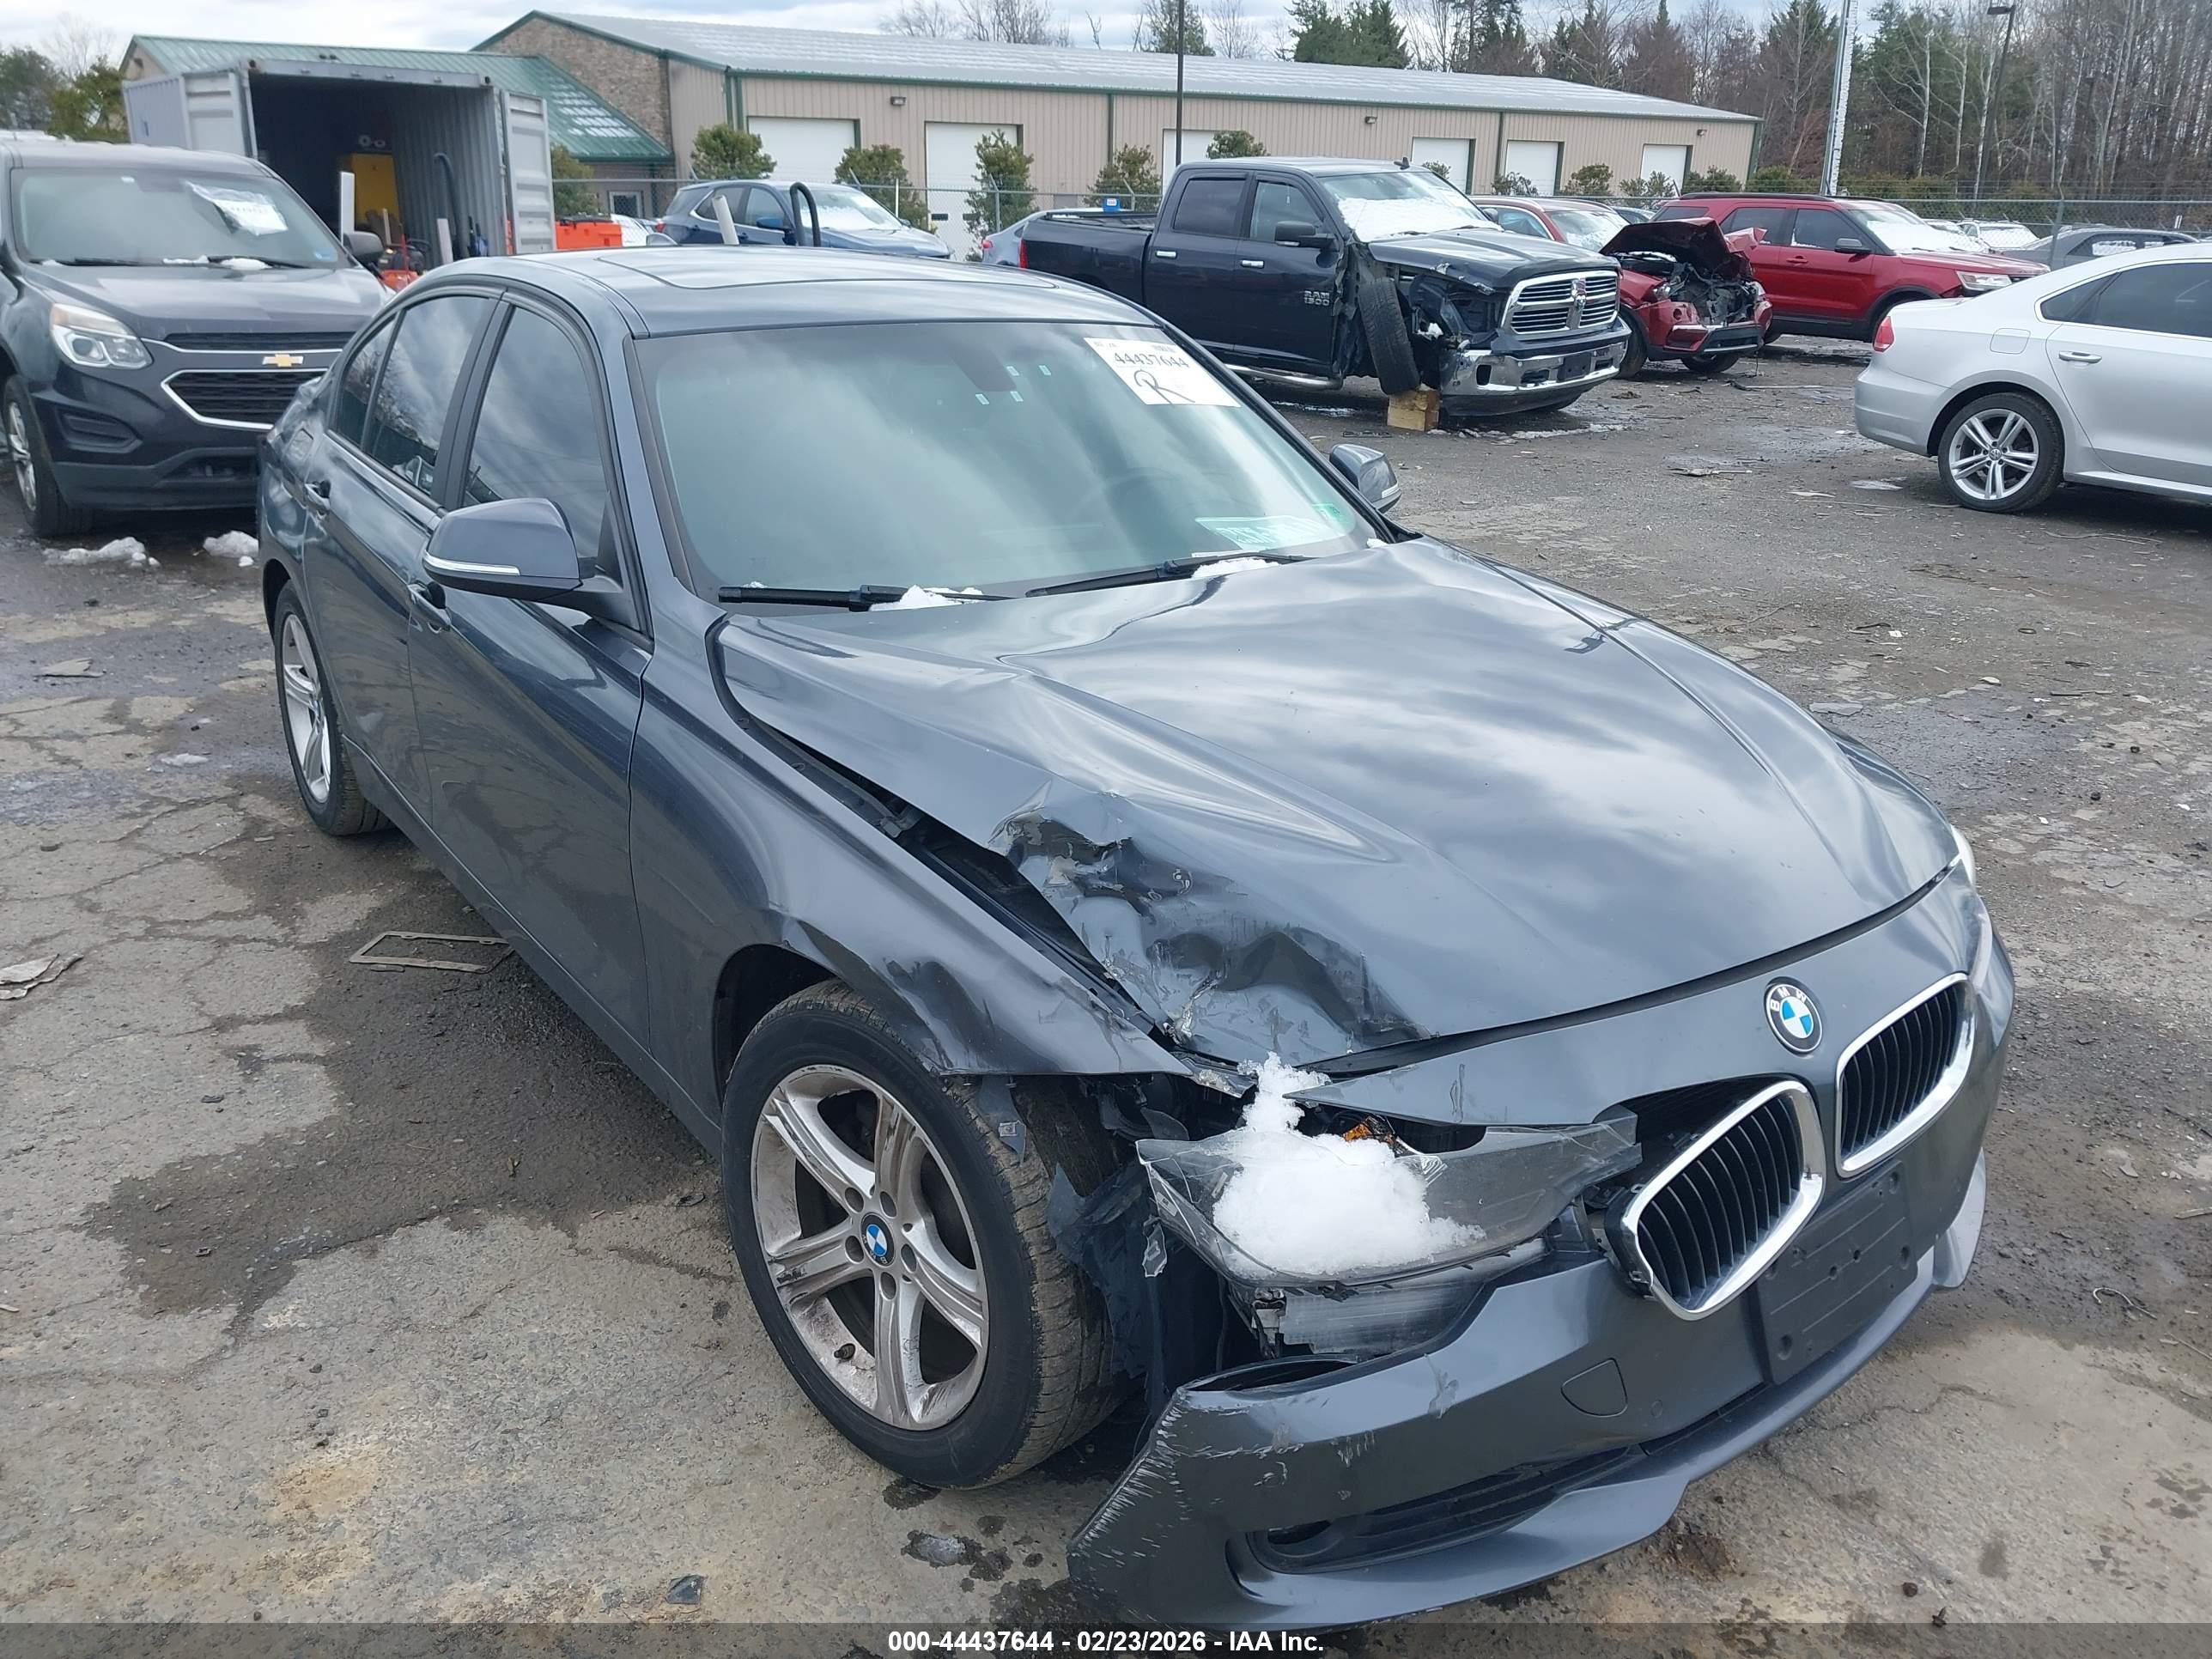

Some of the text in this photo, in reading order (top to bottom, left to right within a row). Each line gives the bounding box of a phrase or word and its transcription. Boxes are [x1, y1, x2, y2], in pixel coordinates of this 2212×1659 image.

[1304, 290, 1330, 299] RAM
[1304, 297, 1330, 306] 1500
[1114, 352, 1189, 368] 44437644
[1770, 987, 1807, 1012] BMW
